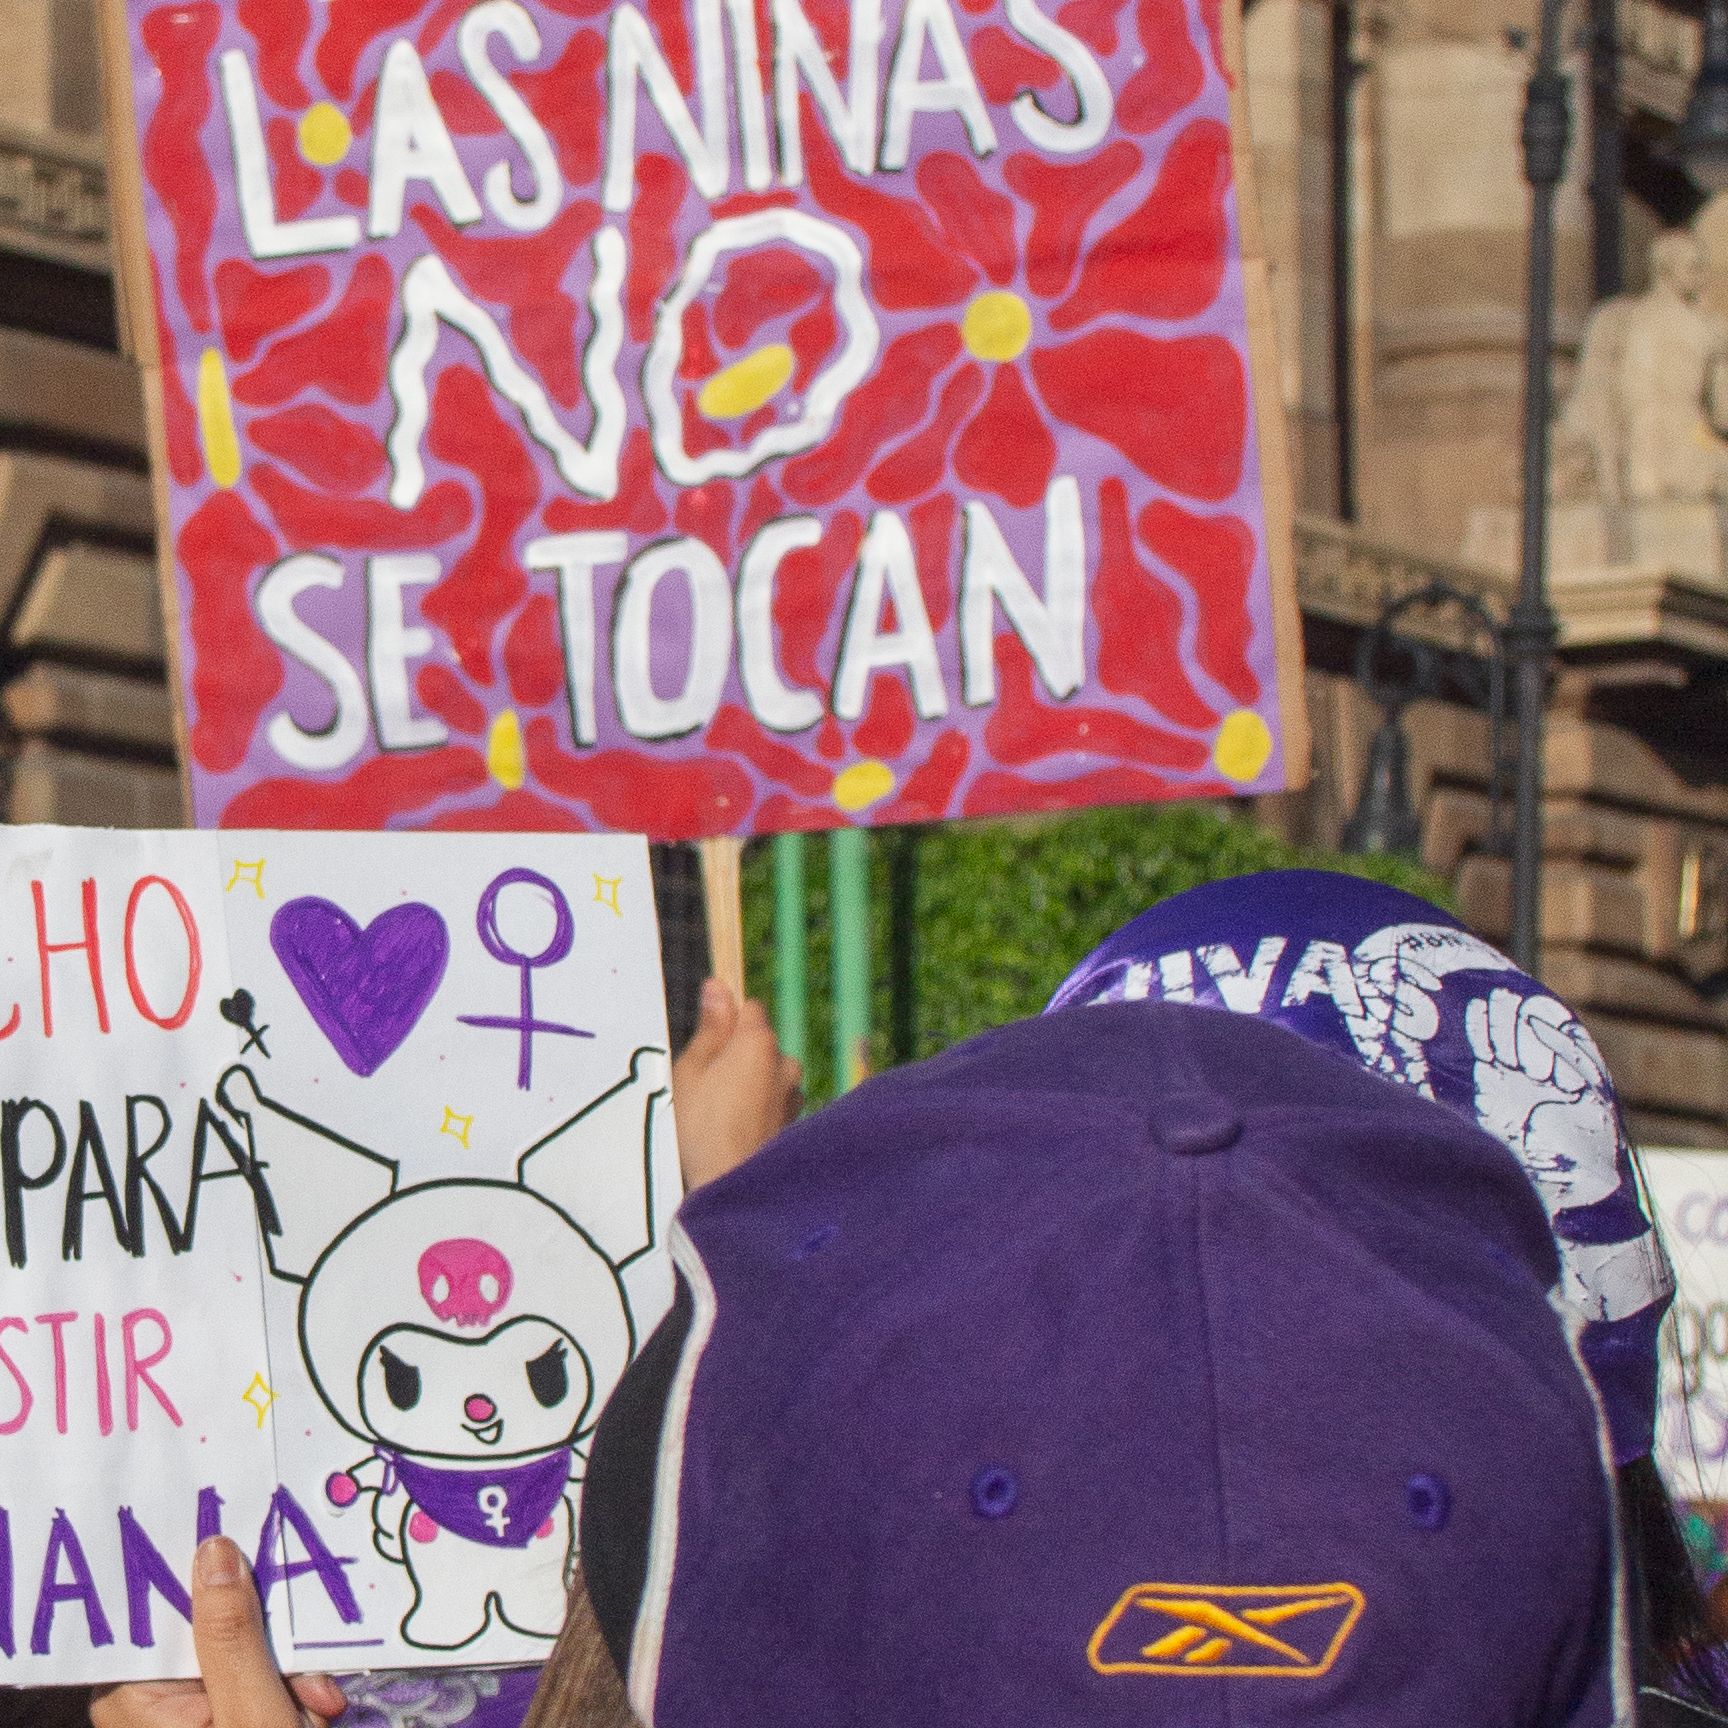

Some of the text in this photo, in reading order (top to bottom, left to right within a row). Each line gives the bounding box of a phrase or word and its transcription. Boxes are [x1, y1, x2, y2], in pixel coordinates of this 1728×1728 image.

[387, 206, 878, 511] NO
[253, 474, 1087, 769] SE TOCAN
[0, 1094, 283, 1270] PARA
